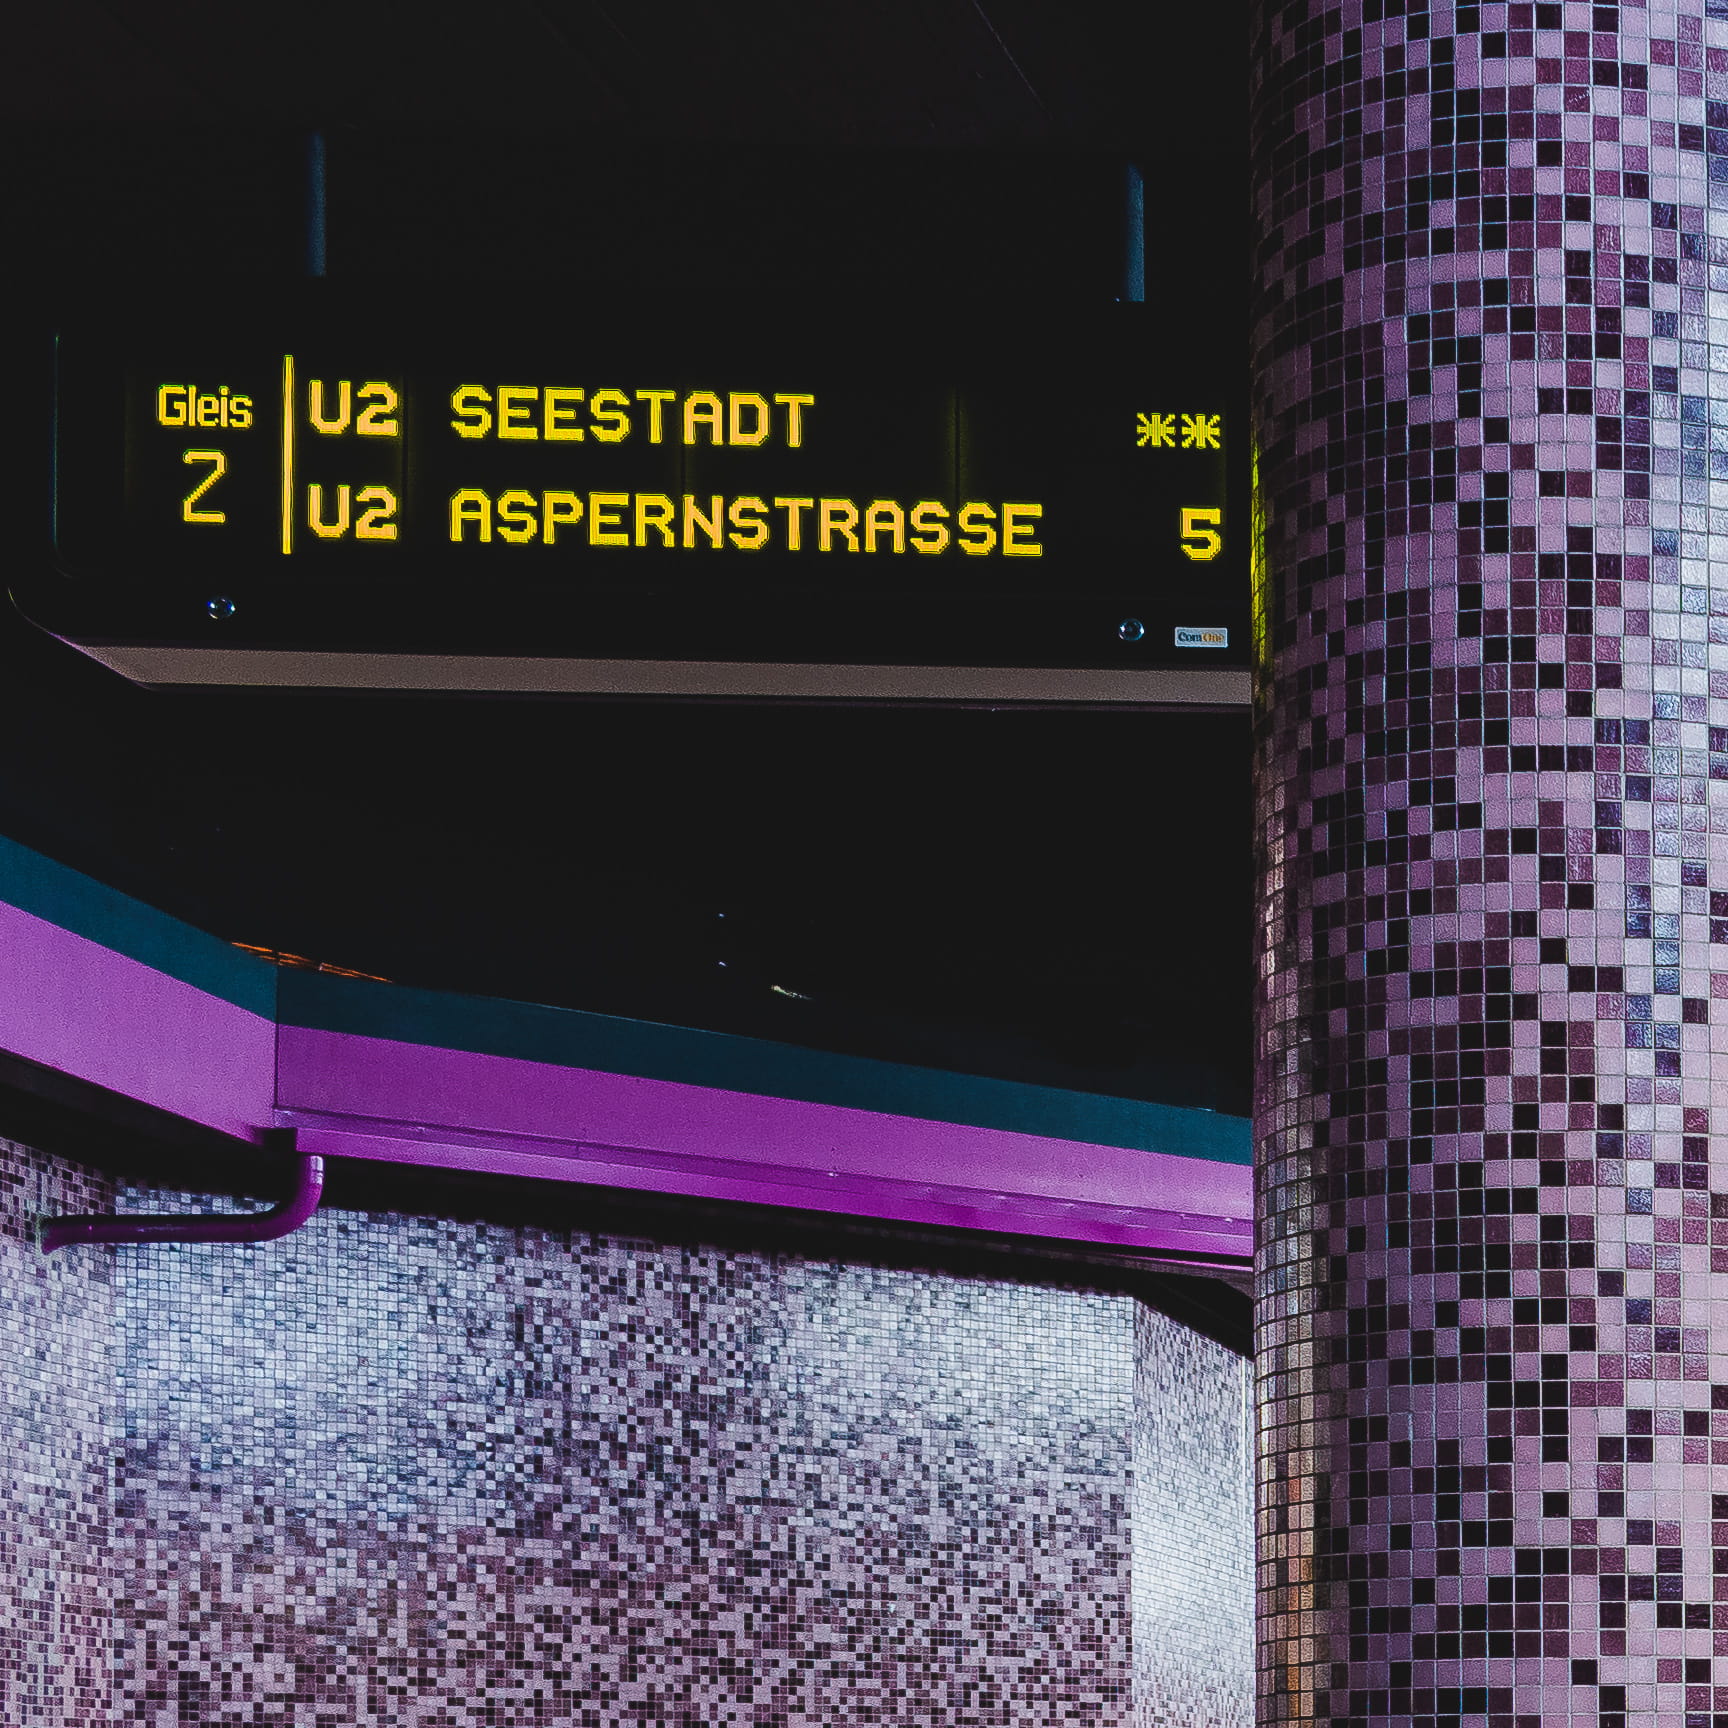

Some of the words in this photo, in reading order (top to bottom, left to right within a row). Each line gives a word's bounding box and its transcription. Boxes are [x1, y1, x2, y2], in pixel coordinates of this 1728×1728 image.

[158, 384, 253, 428] Gleis
[309, 380, 398, 436] U2
[451, 384, 815, 448] SEESTADT
[182, 448, 227, 523] 2
[308, 483, 398, 540] U2
[450, 487, 1043, 557] ASPERNSTRASSE
[1179, 506, 1222, 562] 5
